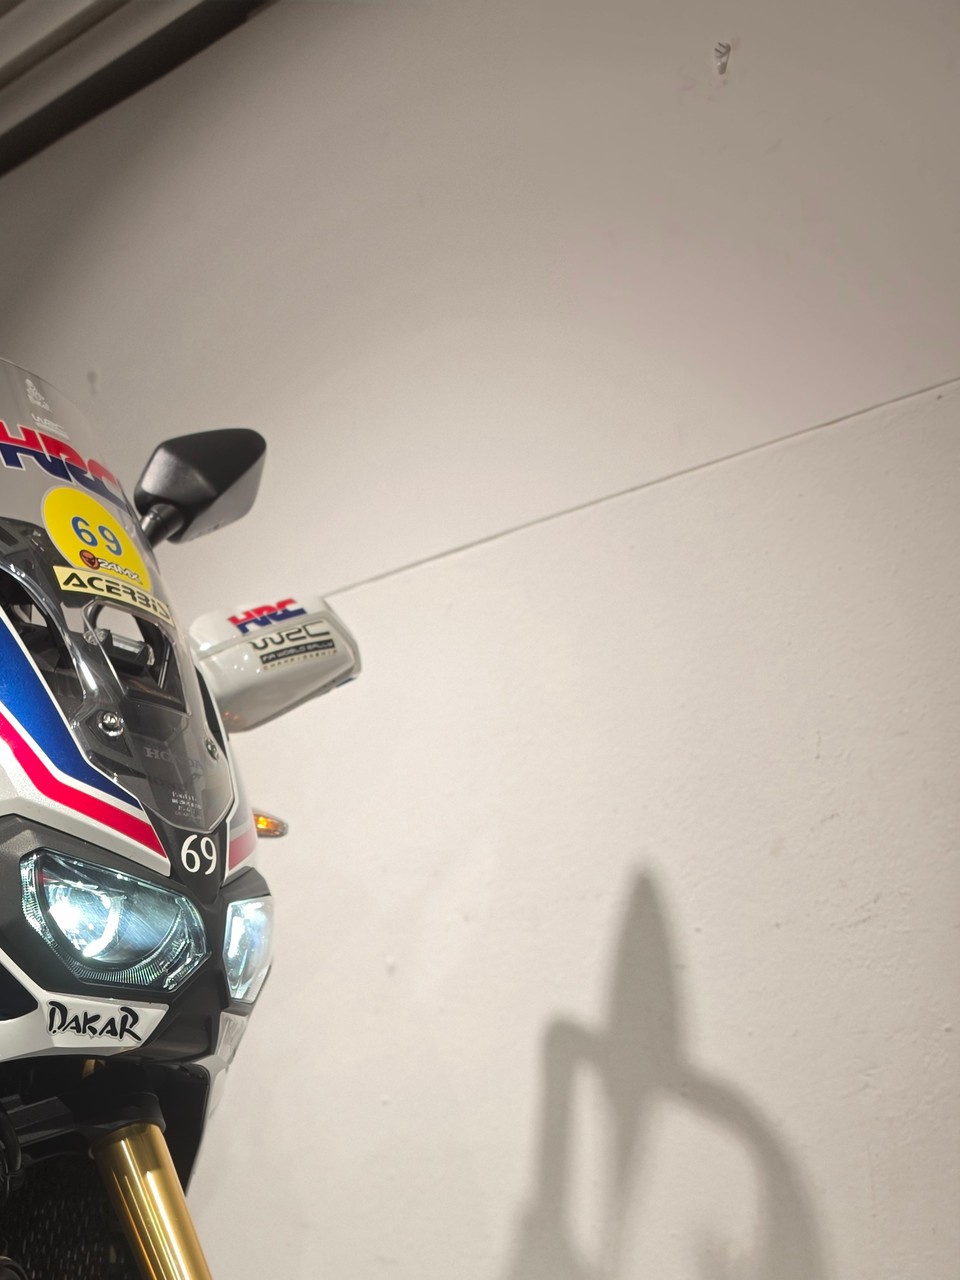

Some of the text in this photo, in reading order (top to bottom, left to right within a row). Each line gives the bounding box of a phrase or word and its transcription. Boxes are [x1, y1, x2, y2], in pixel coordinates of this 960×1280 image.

[71, 516, 123, 556] 69
[62, 572, 171, 620] ACERBIS
[227, 598, 308, 635] HRC
[249, 620, 330, 650] WRC
[181, 834, 217, 876] 69
[48, 1001, 142, 1042] DAKAR
